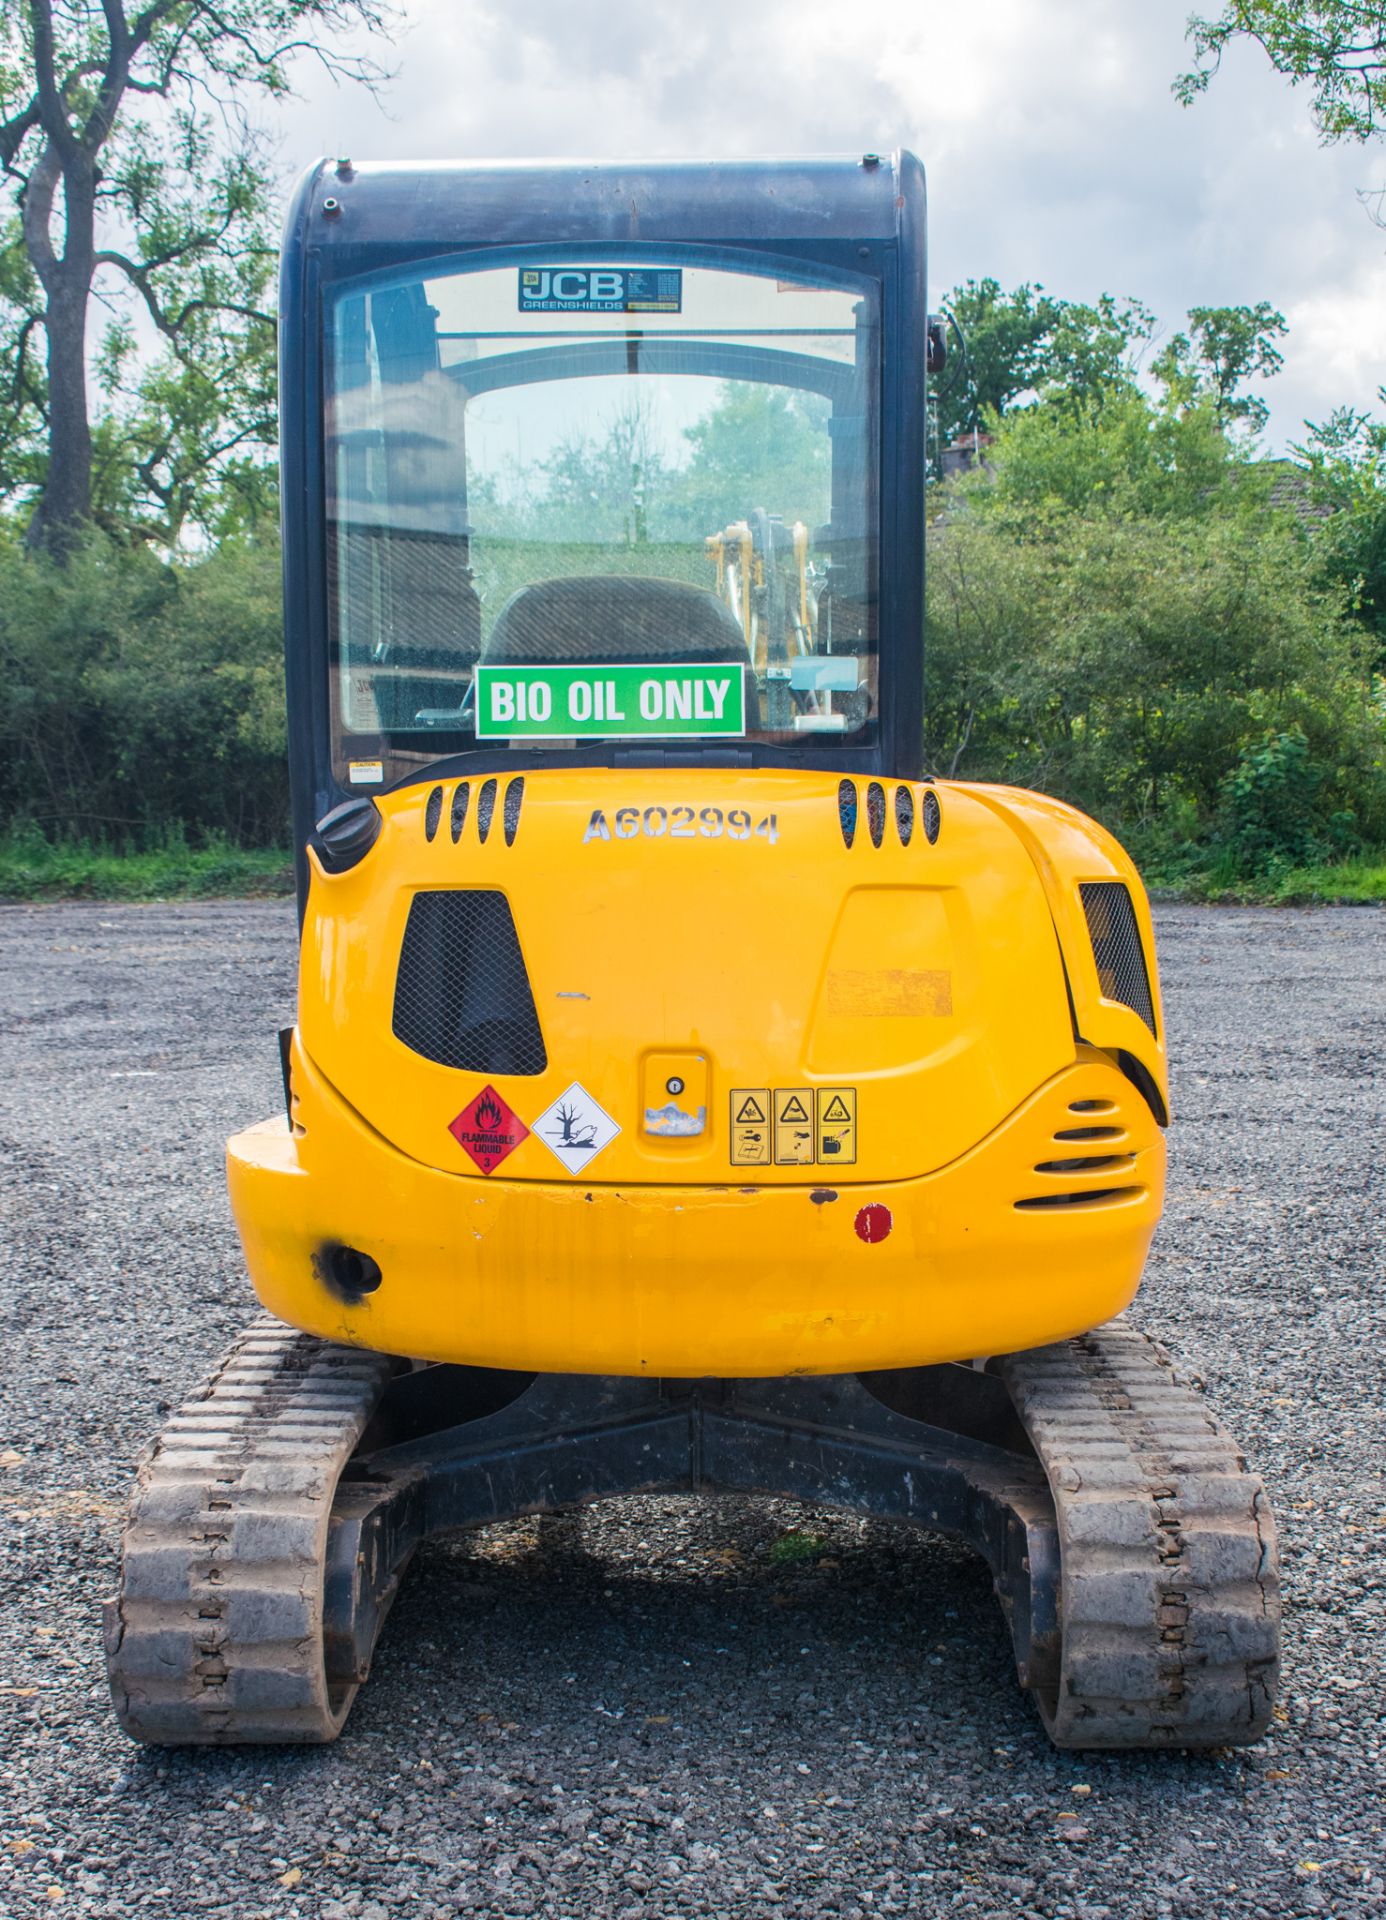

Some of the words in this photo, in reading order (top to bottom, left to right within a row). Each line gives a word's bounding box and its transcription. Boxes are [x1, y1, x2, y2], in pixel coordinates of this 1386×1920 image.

[523, 272, 624, 300] JCB
[523, 301, 623, 310] GREENSHIELDS
[491, 681, 551, 722] BIO
[568, 680, 625, 721] OIL
[639, 679, 732, 720] ONLY
[582, 806, 780, 845] A602994
[462, 1132, 514, 1144] FLAMMABLE
[474, 1143, 502, 1154] LIQUID
[484, 1157, 491, 1167] 3
